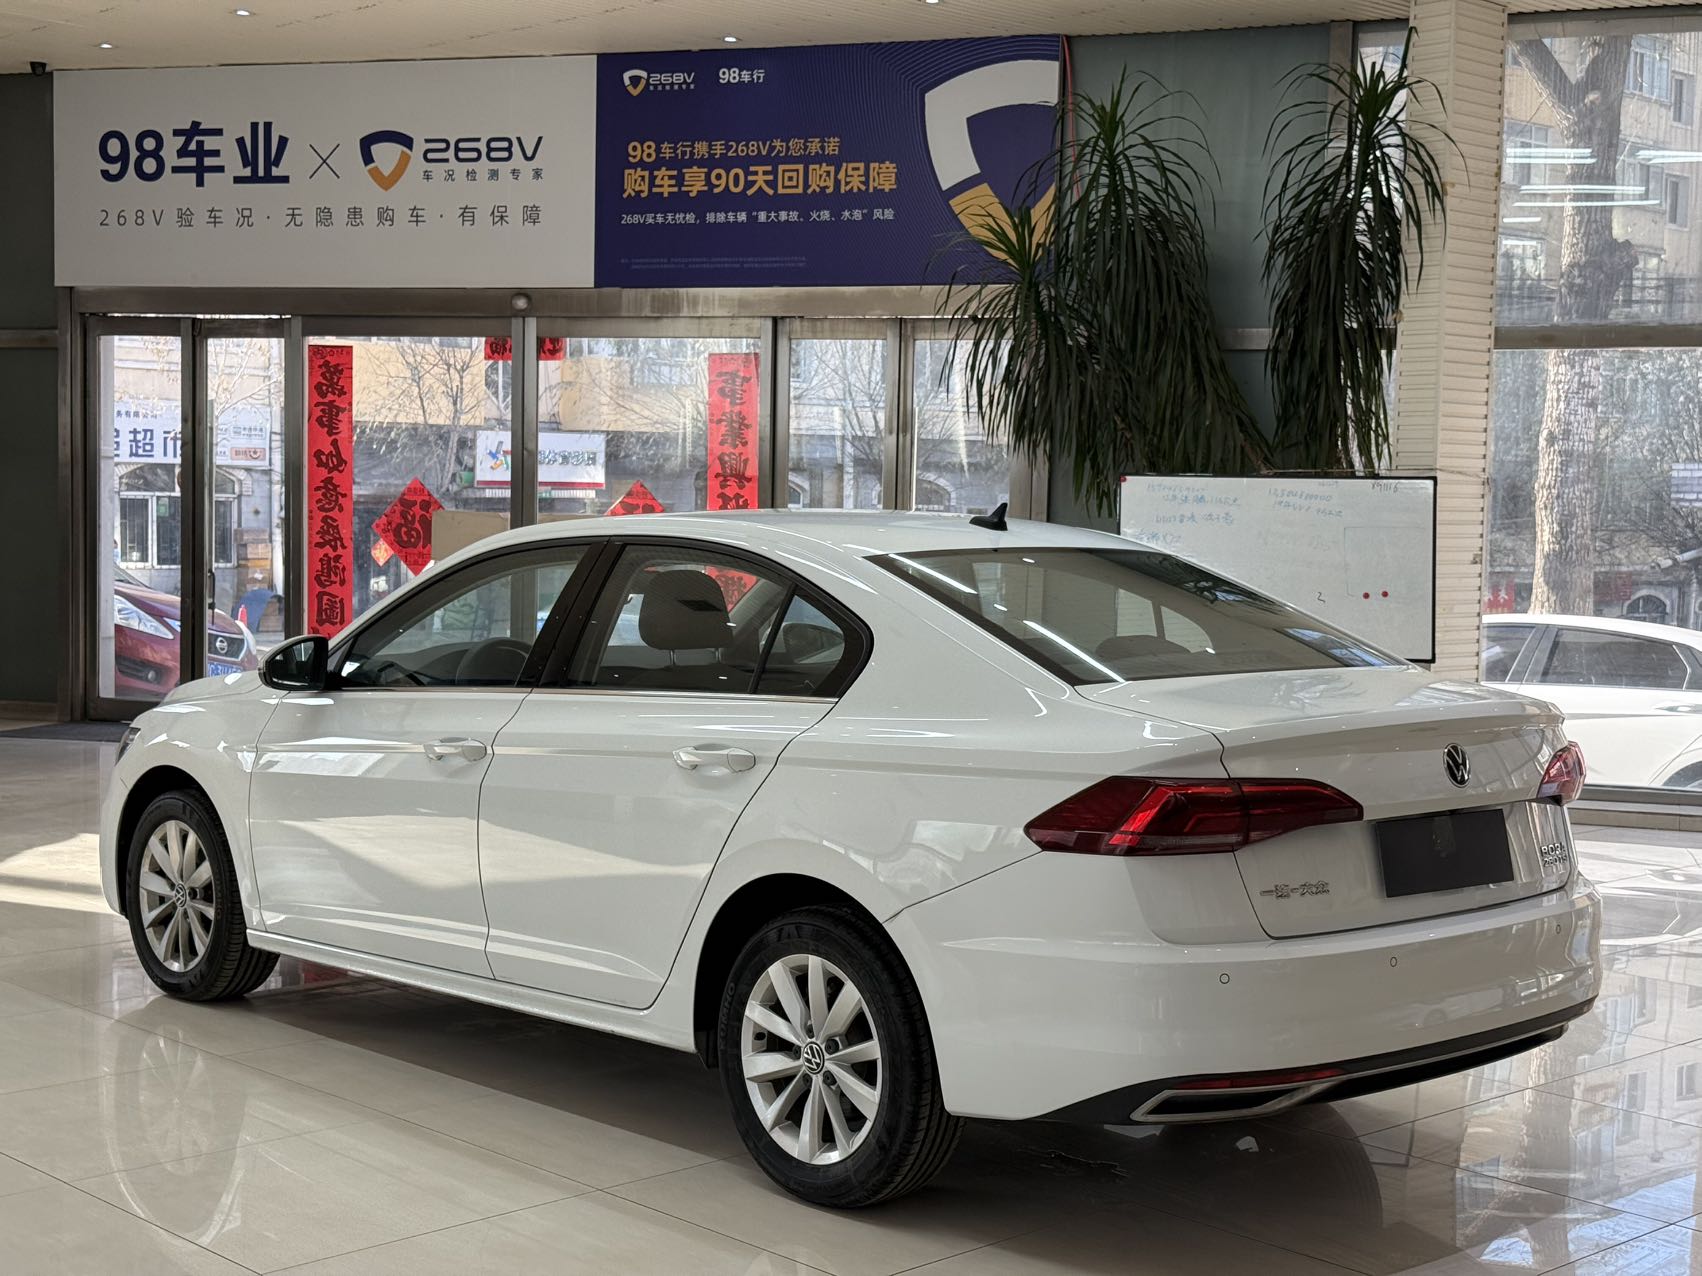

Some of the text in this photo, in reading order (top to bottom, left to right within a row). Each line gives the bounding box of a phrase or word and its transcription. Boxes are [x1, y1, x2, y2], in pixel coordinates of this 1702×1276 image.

[649, 72, 695, 84] 268V
[719, 68, 765, 84] 98车行
[98, 120, 290, 188] 98车业
[422, 136, 543, 163] 268V
[422, 168, 543, 182] 车况检测专家
[622, 161, 898, 198] 购车享90天回购保障
